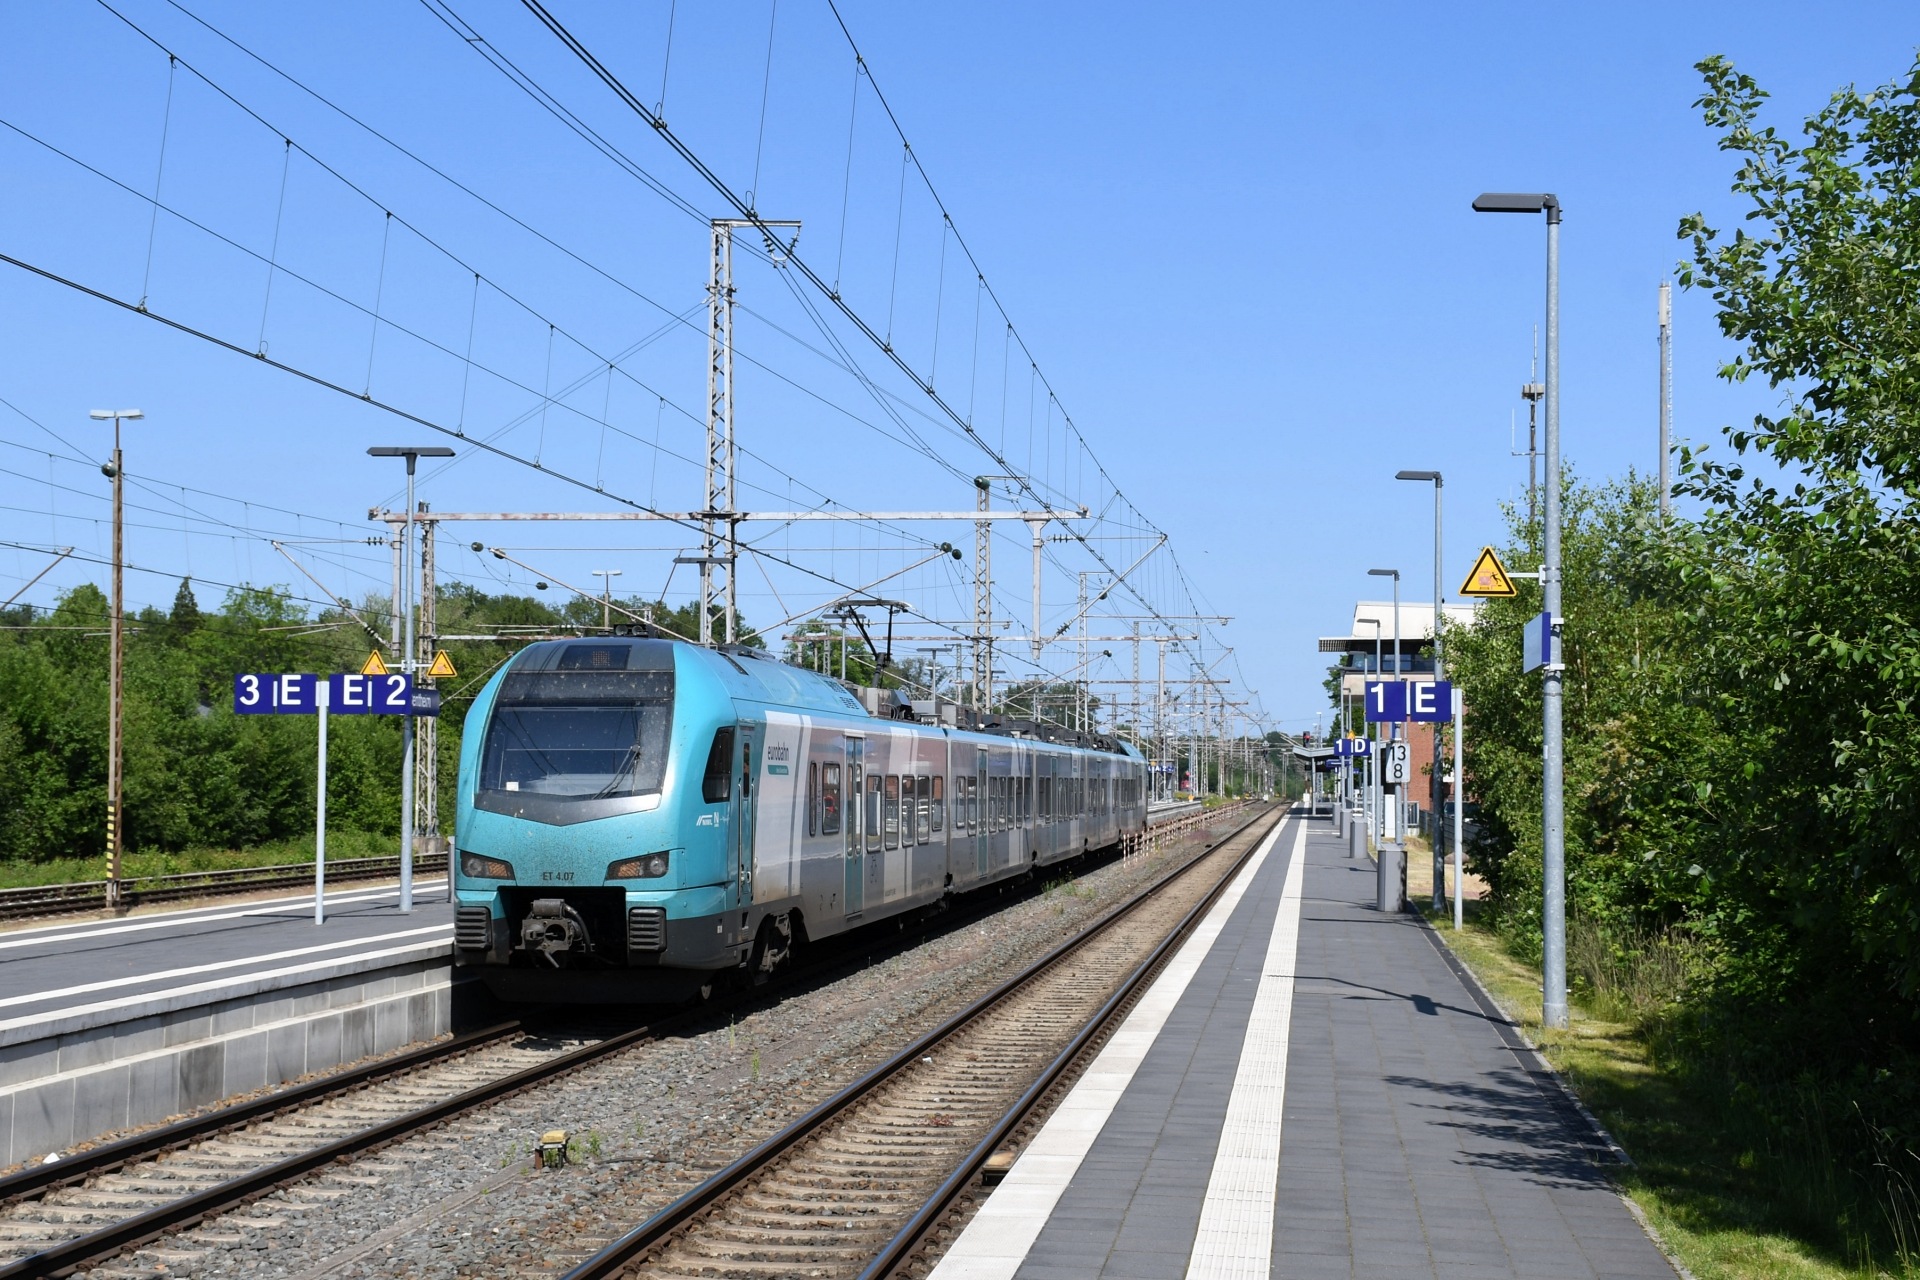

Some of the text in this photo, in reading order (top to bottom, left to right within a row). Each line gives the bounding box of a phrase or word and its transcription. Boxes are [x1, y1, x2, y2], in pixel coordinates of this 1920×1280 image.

[239, 674, 302, 705] 3 E
[343, 674, 406, 705] E 2
[1370, 682, 1437, 713] 1 E
[767, 741, 789, 761] eurobahn
[1335, 738, 1366, 753] 1 D
[1390, 745, 1406, 761] 13
[1393, 763, 1403, 779] 8
[542, 871, 575, 881] ET 4.07
